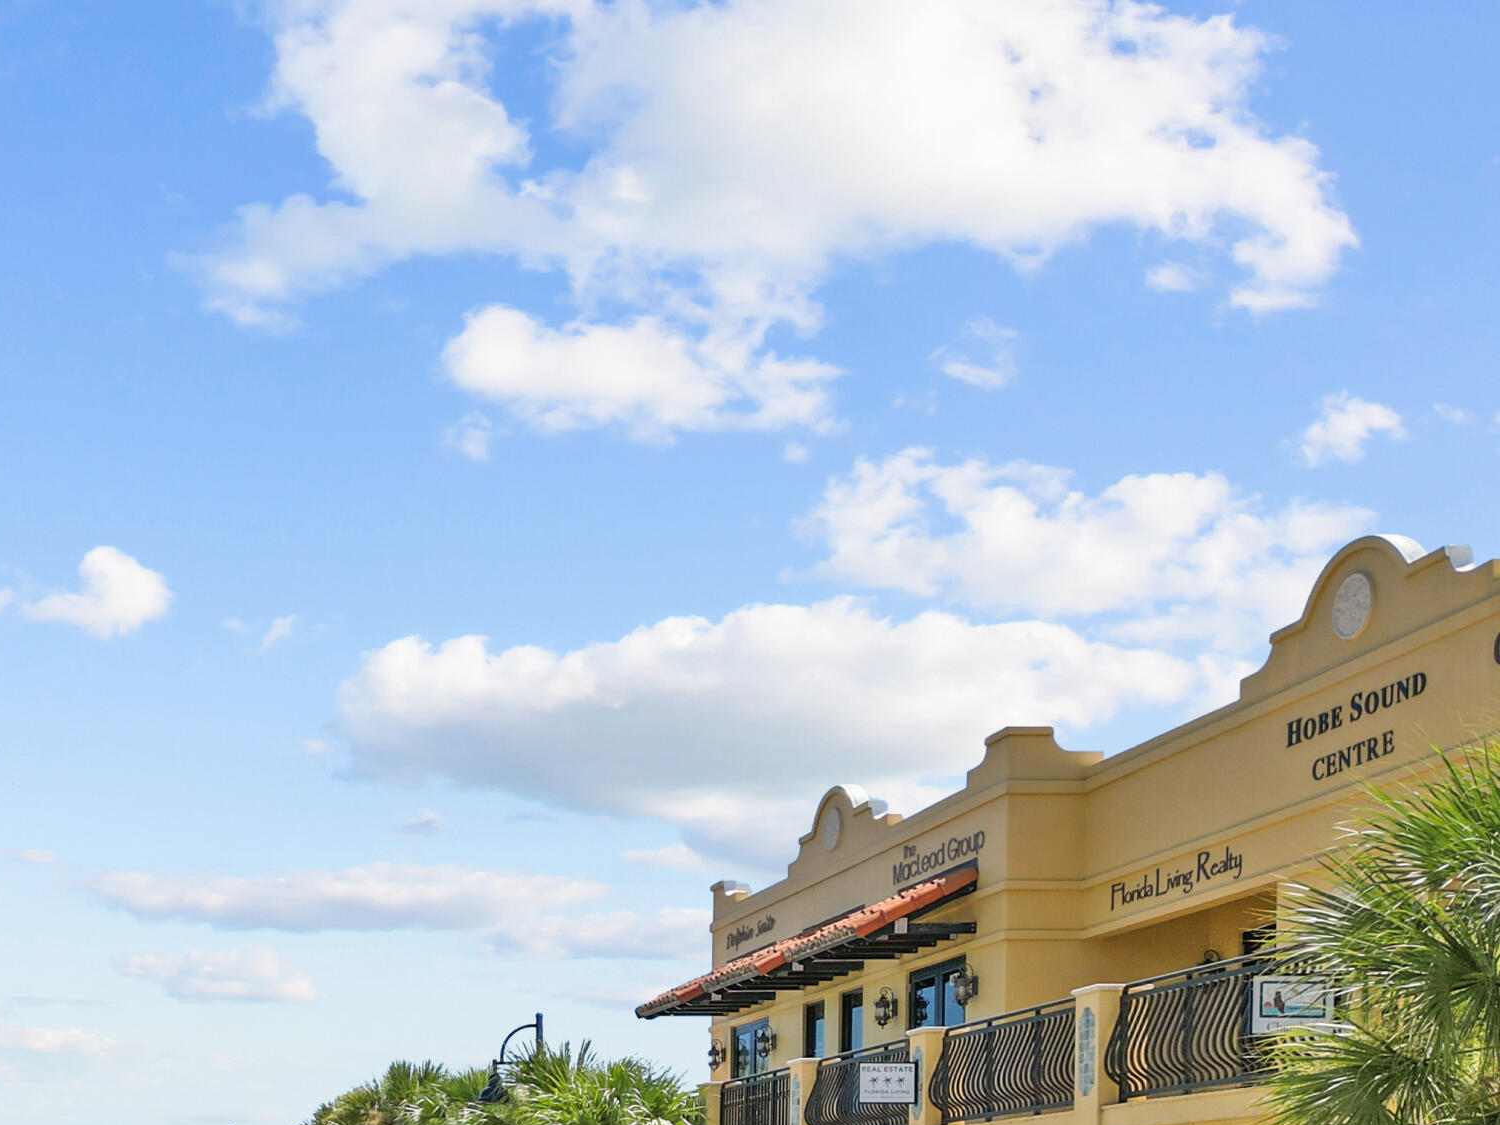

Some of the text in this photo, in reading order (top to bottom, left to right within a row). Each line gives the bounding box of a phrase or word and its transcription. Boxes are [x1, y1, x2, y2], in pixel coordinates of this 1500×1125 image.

[1312, 730, 1395, 781] CENTRE
[948, 830, 985, 861] Group
[1110, 846, 1243, 911] Florida Living Realty
